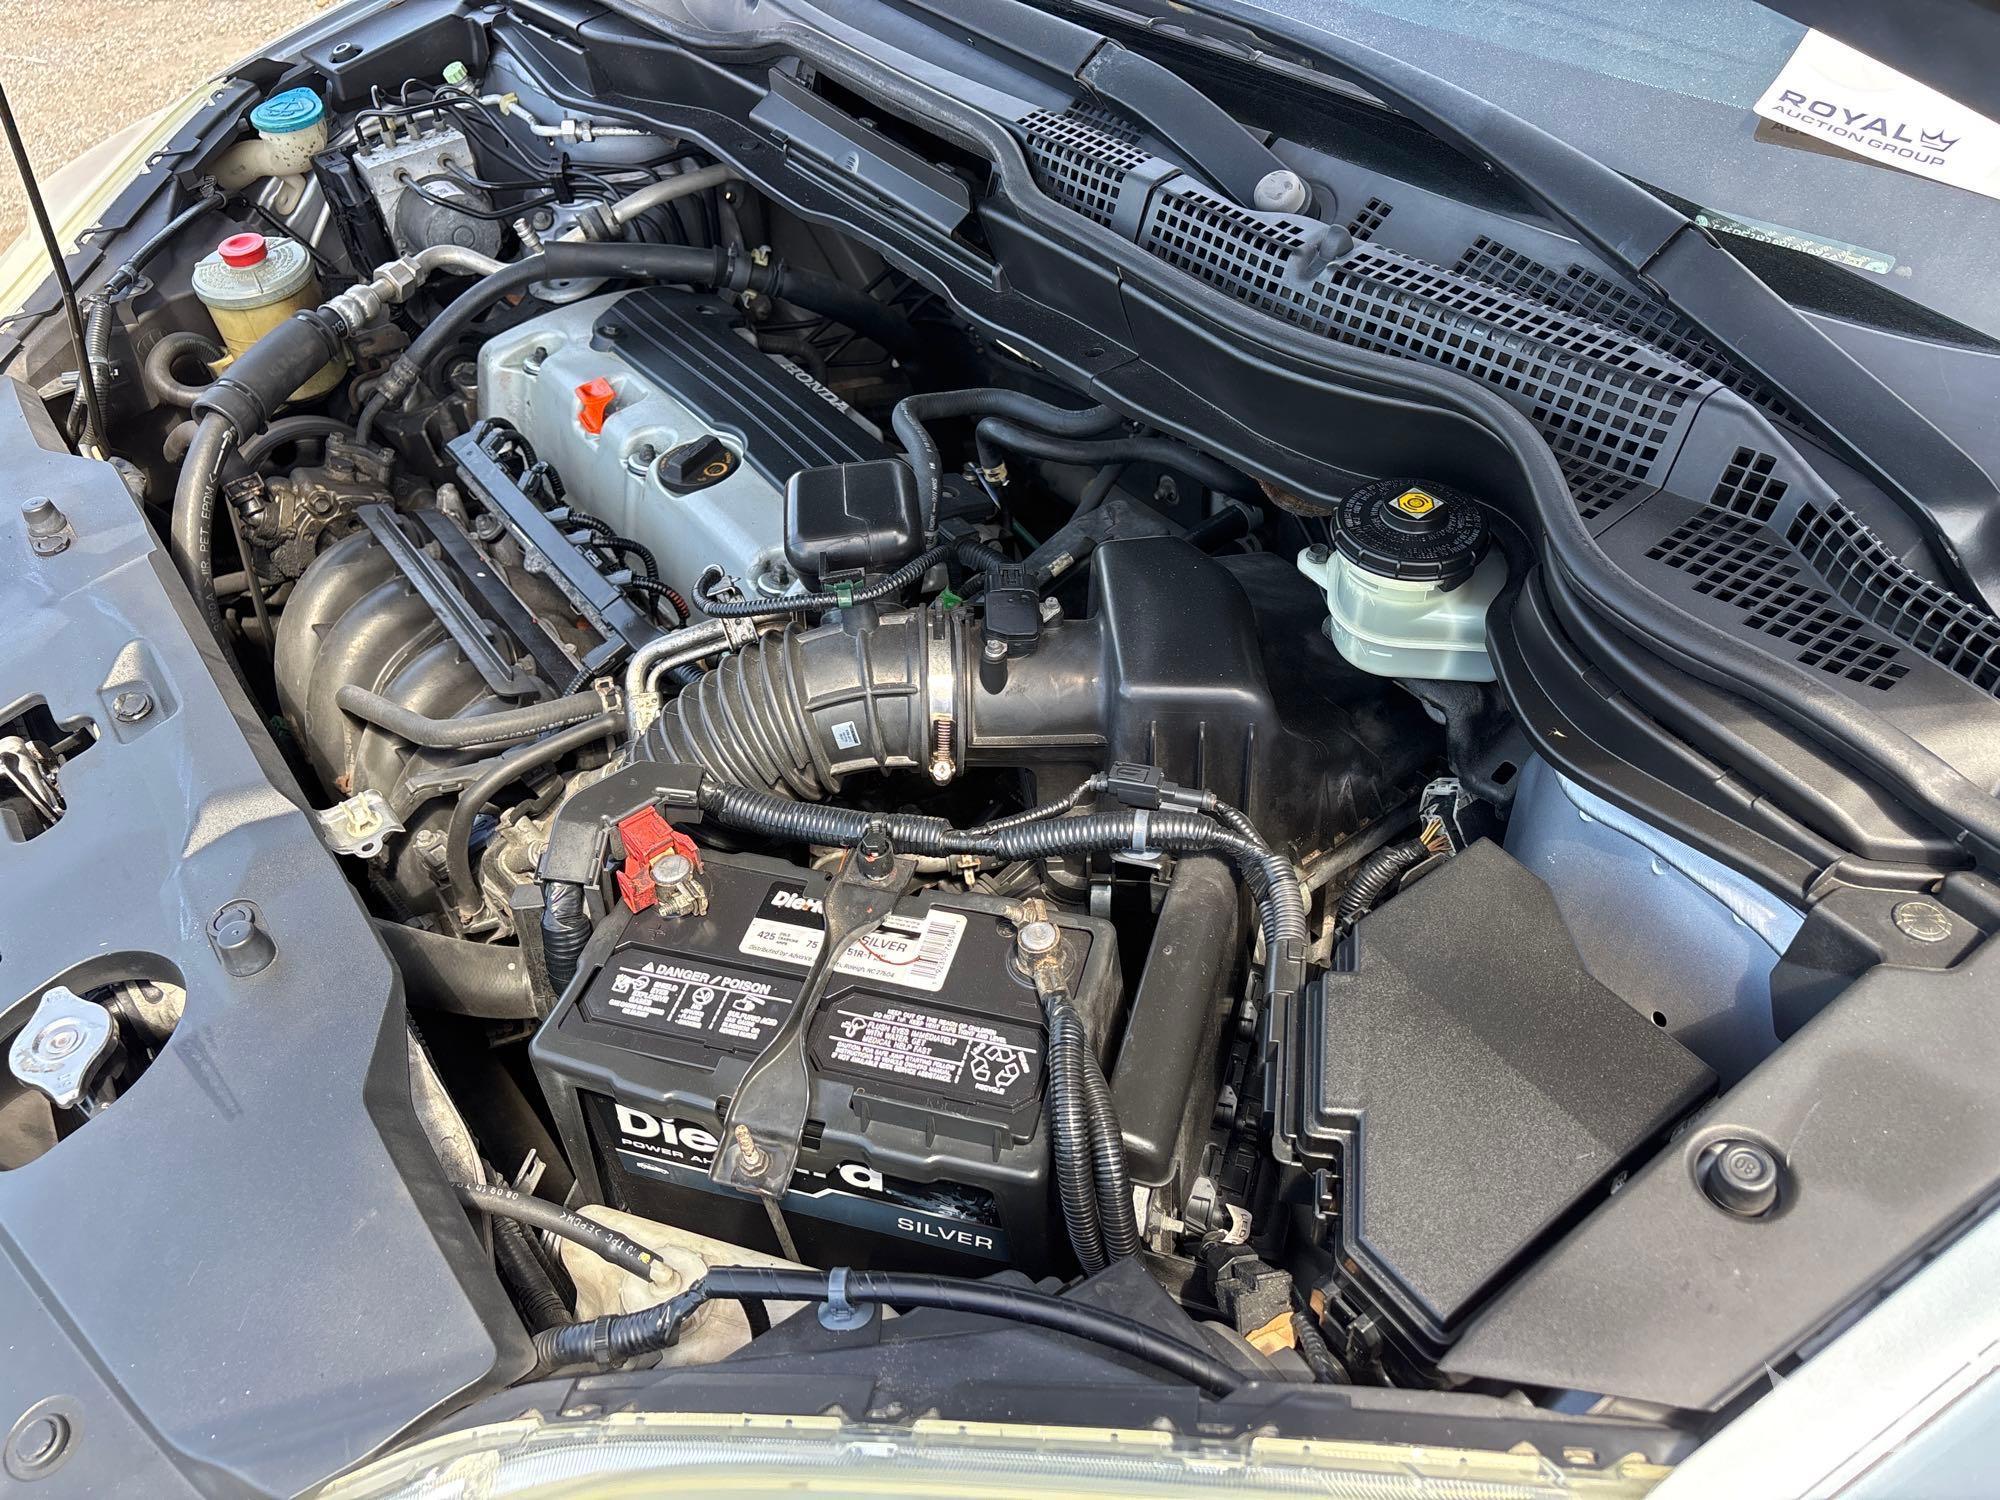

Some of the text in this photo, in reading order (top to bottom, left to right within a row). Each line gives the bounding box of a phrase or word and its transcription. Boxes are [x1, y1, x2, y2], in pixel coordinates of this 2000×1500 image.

[1778, 89, 1912, 144] ROYAL
[1772, 105, 1864, 143] AUCTION
[1867, 138, 1946, 167] GROUP
[780, 363, 850, 415] HONDA
[757, 931, 776, 941] 425
[806, 940, 819, 949] 75
[861, 935, 908, 952] SILVER
[655, 964, 711, 983] DANGER
[721, 977, 771, 995] POISON
[861, 1035, 932, 1055] MEDICAL HELP FAST
[865, 1028, 883, 1037] WITH
[911, 1037, 927, 1046] GET
[867, 1021, 958, 1046] FLUSH EYES IMMEDIATELY
[621, 1138, 685, 1159] POWER
[897, 1217, 993, 1250] SILVER
